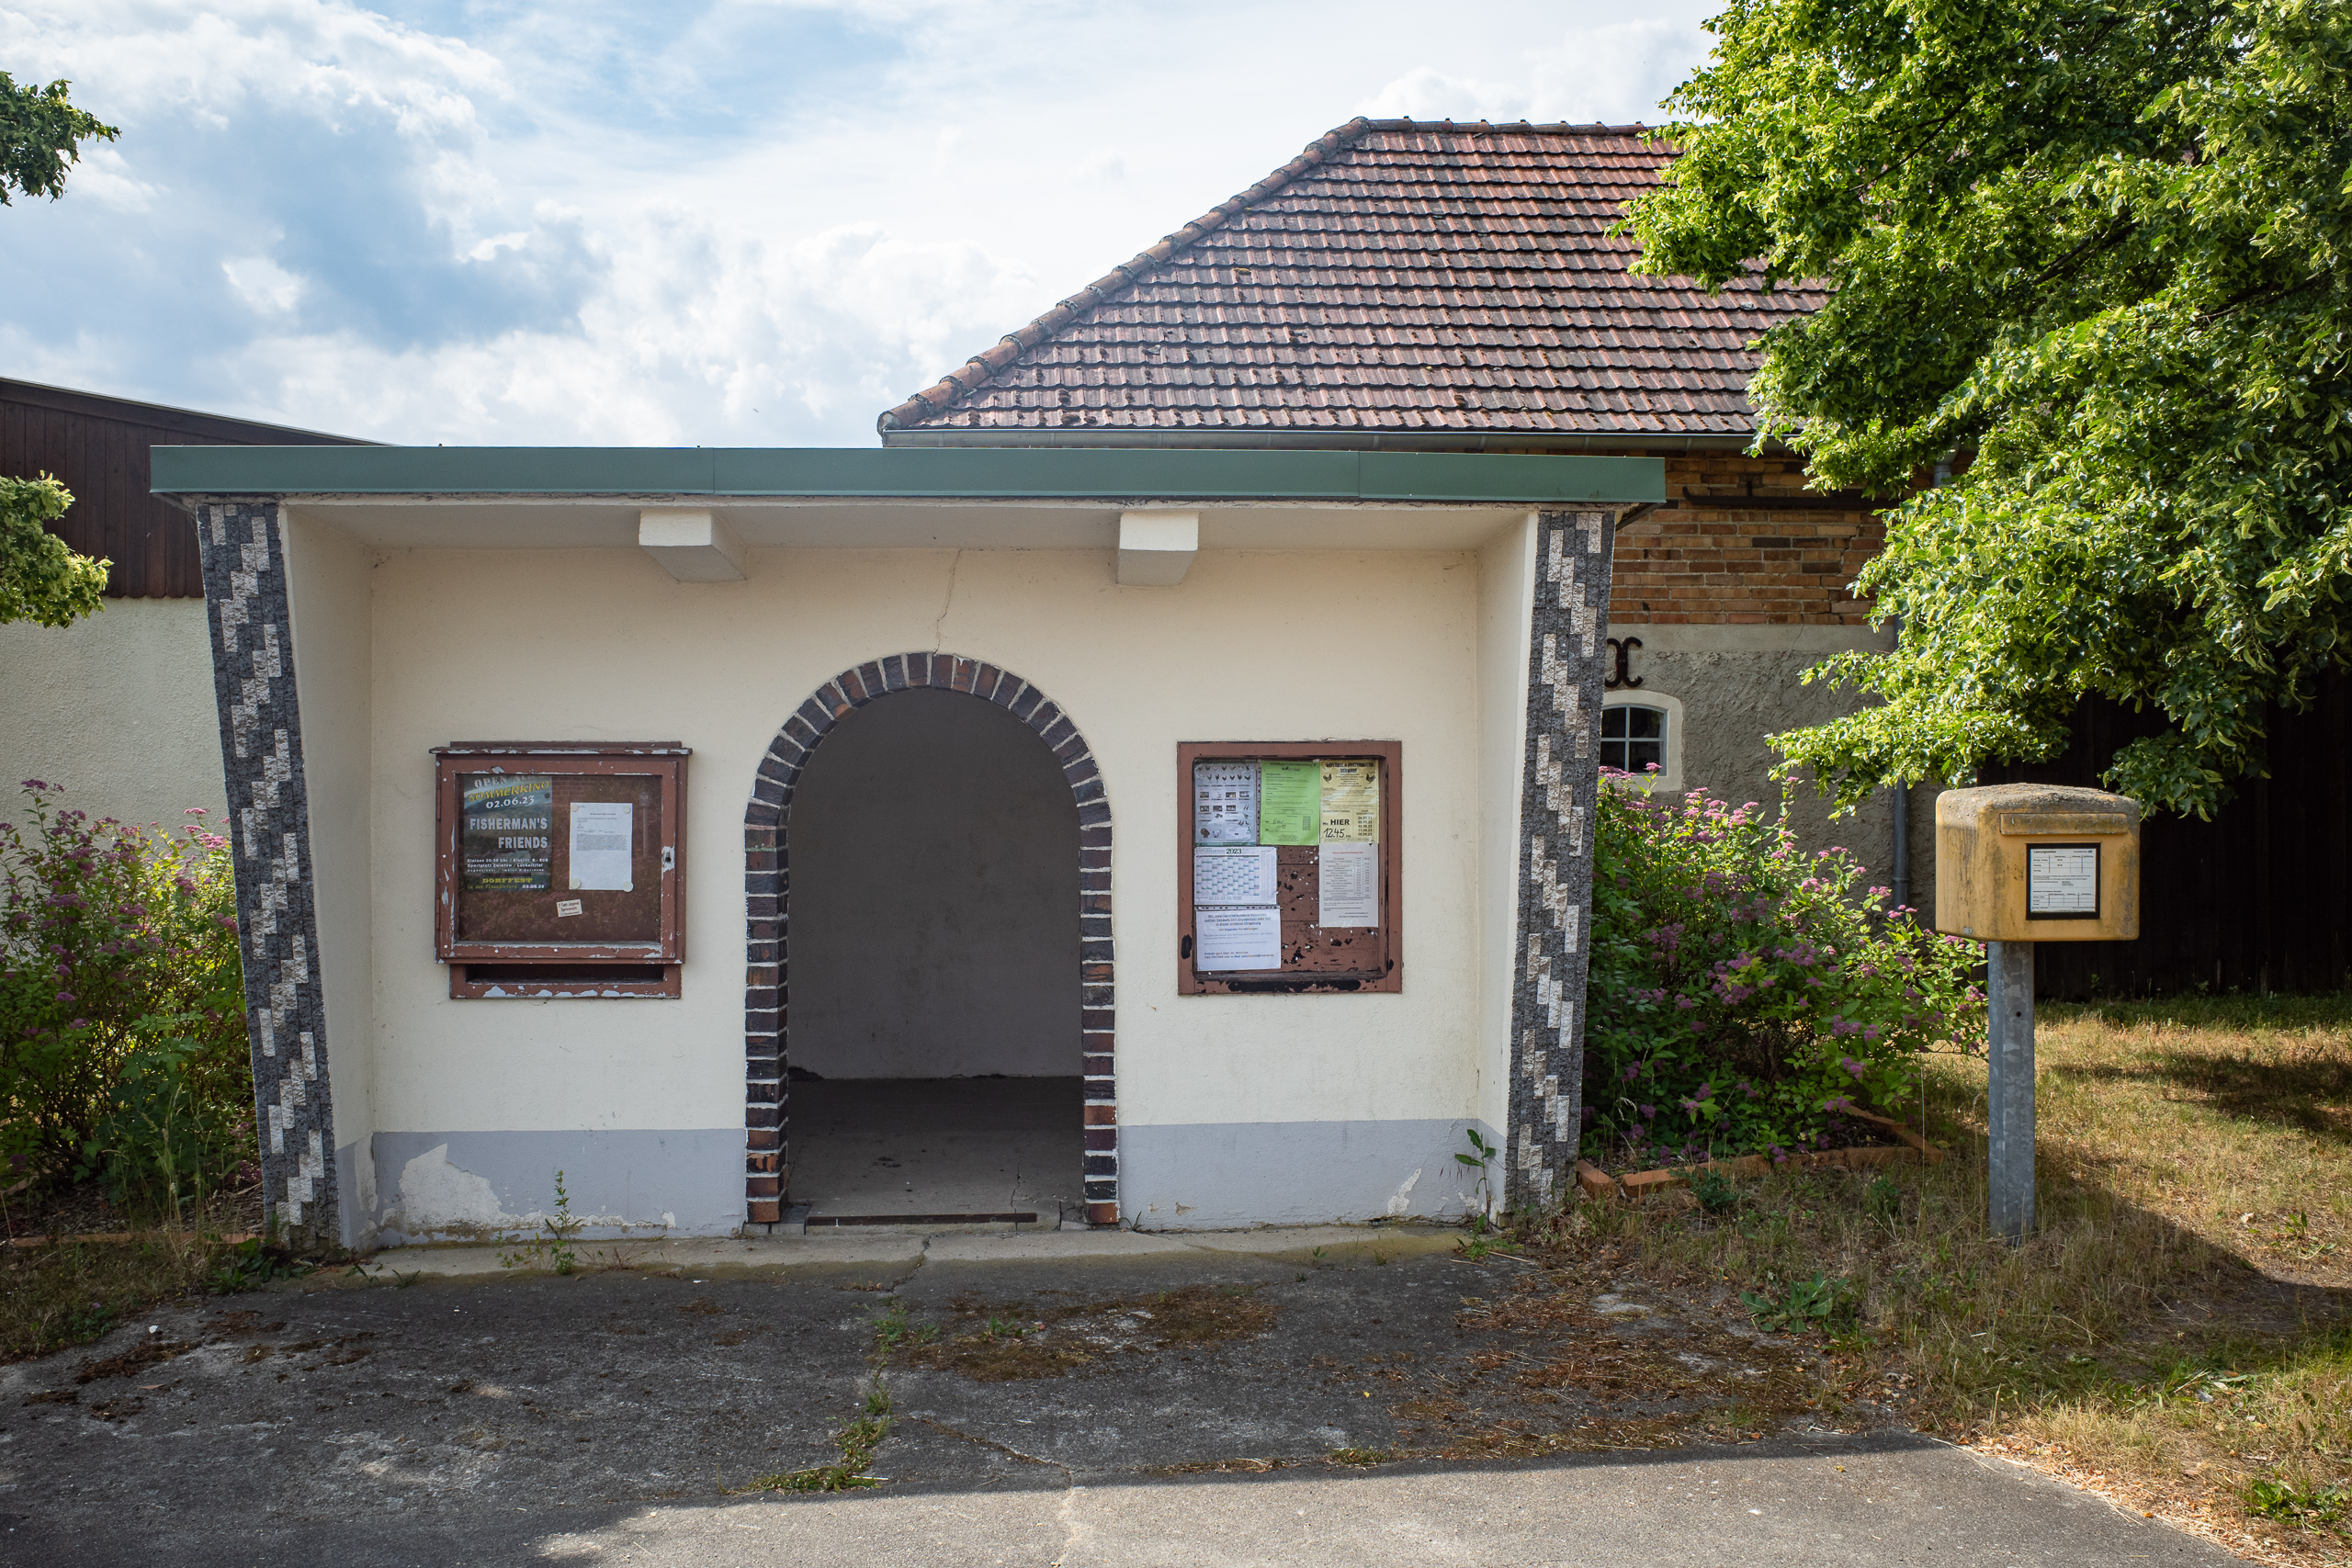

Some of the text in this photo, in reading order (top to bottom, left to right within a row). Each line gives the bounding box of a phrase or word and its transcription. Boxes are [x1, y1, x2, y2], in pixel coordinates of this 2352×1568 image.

[474, 775, 507, 788] OPEN
[468, 781, 549, 803] SOMMERKINO
[486, 795, 535, 809] 02.06.23
[469, 818, 548, 830] FISHERMAN'S
[498, 836, 548, 849] FRIENDS
